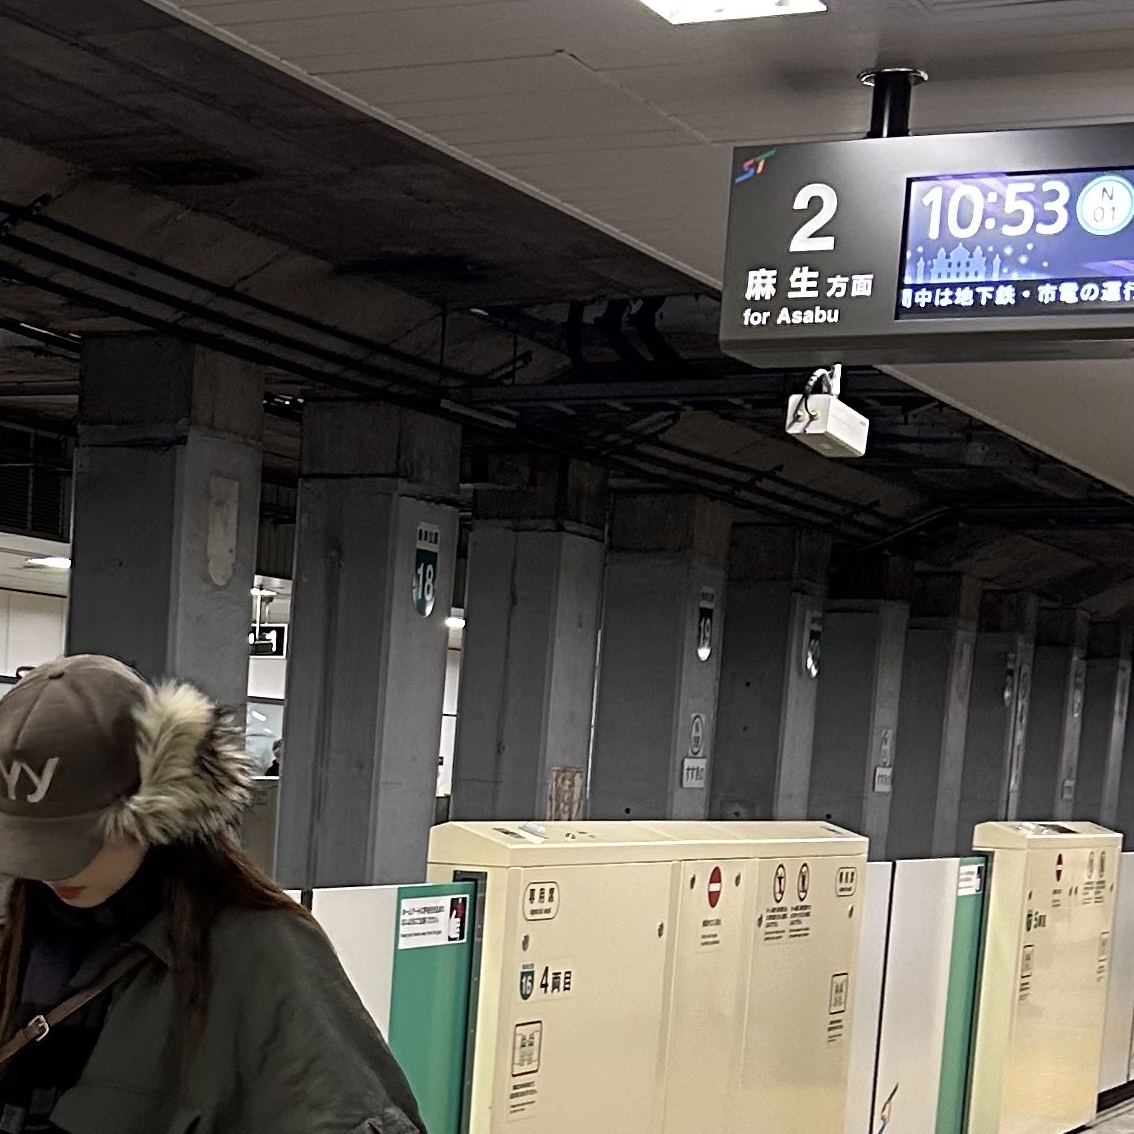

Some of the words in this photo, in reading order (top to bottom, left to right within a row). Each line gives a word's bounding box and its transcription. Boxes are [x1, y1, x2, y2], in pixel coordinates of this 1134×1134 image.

[922, 180, 1070, 240] 10:53
[1101, 186, 1114, 202] N
[789, 182, 838, 253] 2
[742, 308, 771, 326] for
[776, 306, 840, 325] Asabu
[417, 563, 435, 601] 18
